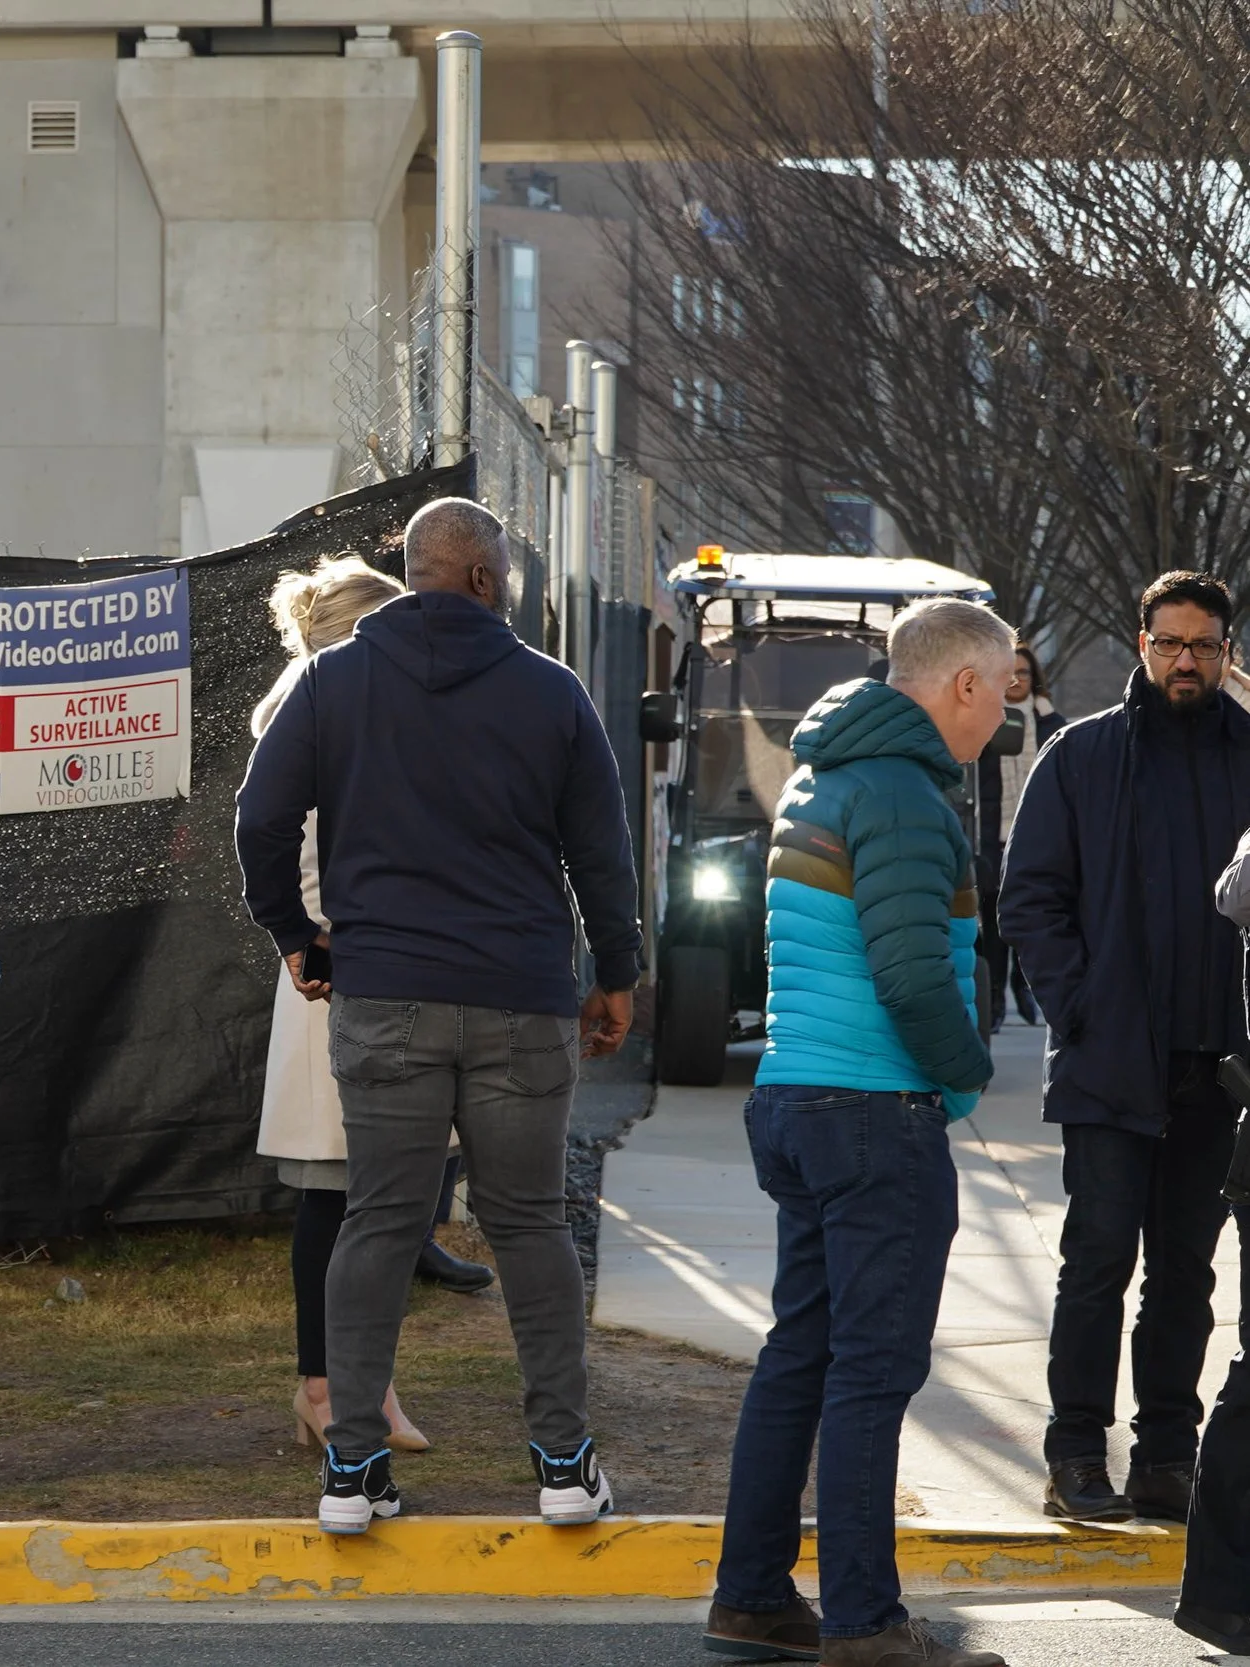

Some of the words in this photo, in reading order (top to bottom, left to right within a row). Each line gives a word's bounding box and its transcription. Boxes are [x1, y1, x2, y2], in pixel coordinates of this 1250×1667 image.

[145, 583, 177, 618] BY
[65, 693, 127, 717] ACTIVE
[30, 713, 161, 743] SURVEILLANCE
[38, 751, 142, 788] MOBILE
[36, 782, 143, 806] VIDEOGUARD
